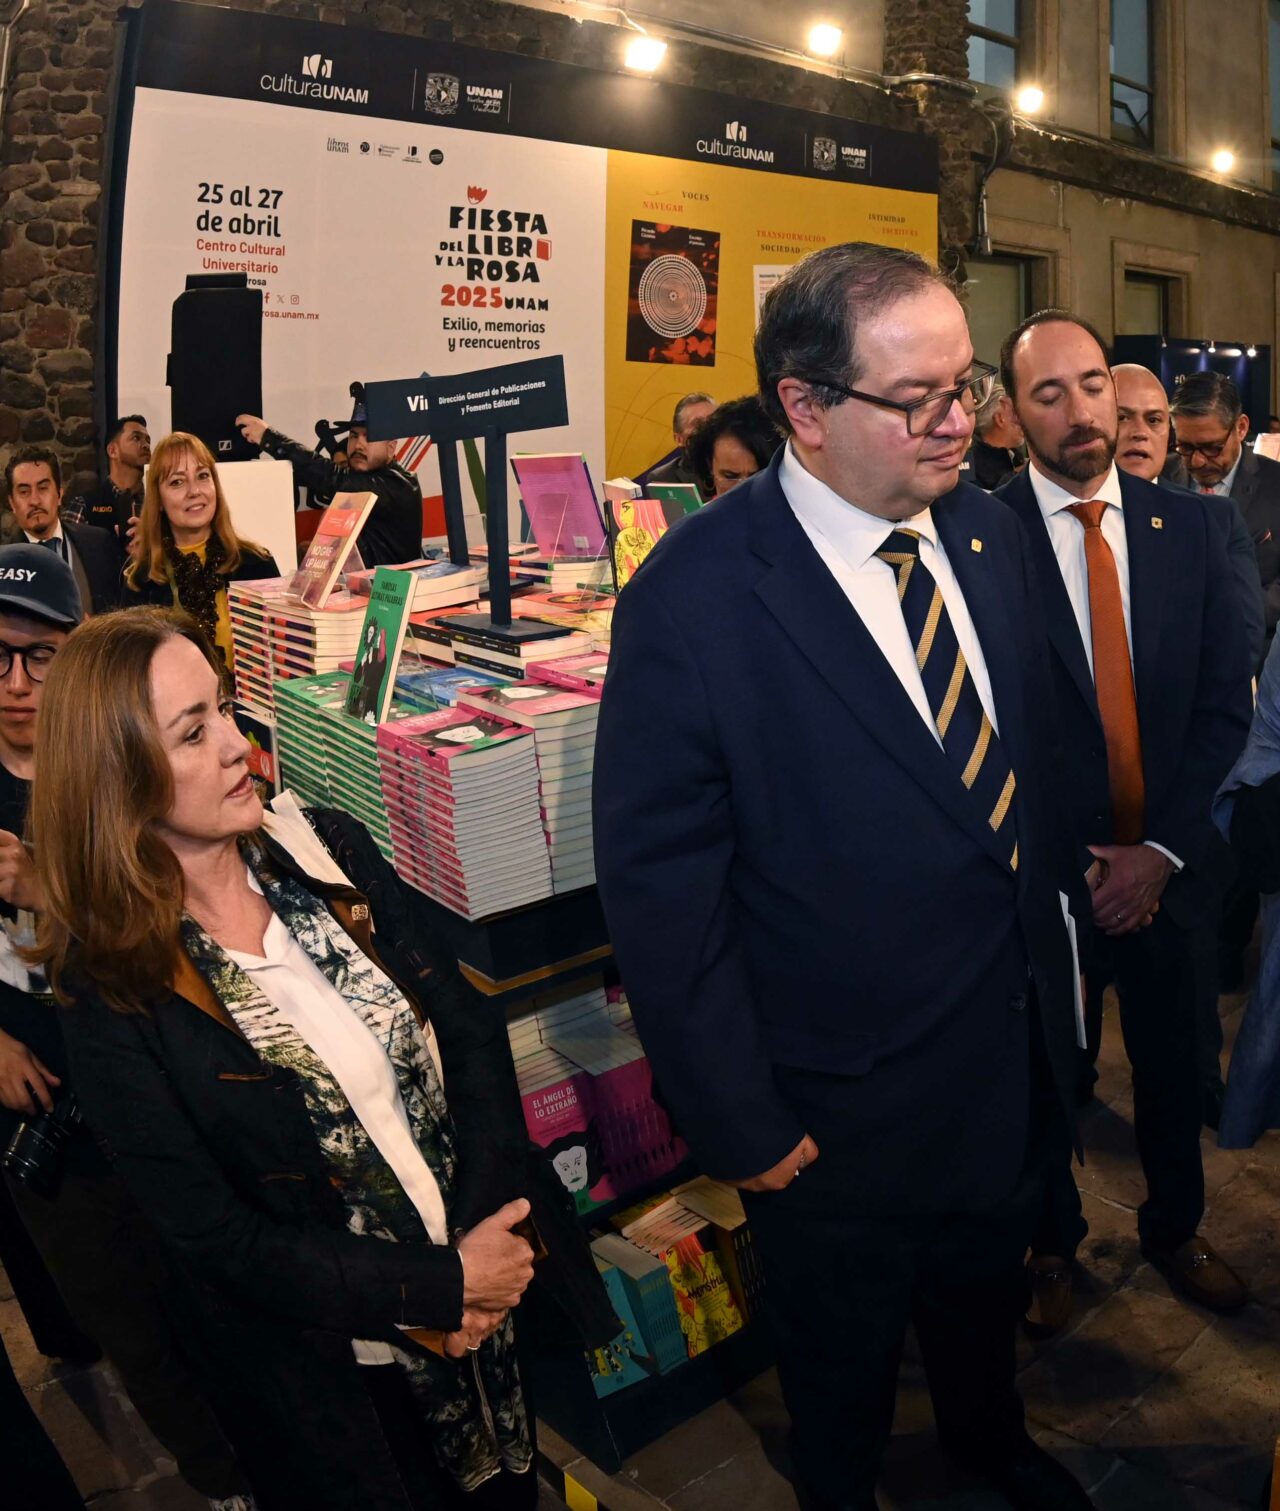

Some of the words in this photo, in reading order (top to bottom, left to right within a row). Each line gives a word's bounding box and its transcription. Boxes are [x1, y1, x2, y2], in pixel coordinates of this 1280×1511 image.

[260, 73, 369, 104] culturaUNAM
[466, 85, 503, 99] UNAM
[696, 138, 774, 163] culturaUNAM
[841, 146, 867, 158] UNAM
[197, 182, 224, 204] 25
[230, 185, 252, 207] al
[257, 188, 284, 209] 27
[682, 191, 710, 201] VOCES
[643, 201, 684, 213] NAVEGAR
[196, 209, 223, 233] de
[228, 213, 281, 238] abril
[449, 206, 548, 234] FIESTA
[868, 213, 906, 224] INTIMIDAD
[756, 230, 827, 243] TRANSFORMACIÓN
[196, 238, 237, 253] Centro
[240, 241, 285, 257] Cultural
[439, 241, 463, 252] DEL
[760, 244, 801, 254] SOCIEDAD
[202, 257, 278, 274] Universitario
[434, 255, 443, 266] Y
[447, 256, 465, 266] LA
[466, 257, 540, 282] ROSA
[440, 284, 503, 308] 2025
[504, 297, 549, 311] UNAM
[443, 316, 481, 333] Exilio,
[485, 320, 545, 334] memorias
[448, 337, 455, 352] y
[459, 336, 540, 350] reencuentros
[438, 393, 465, 405] Dirección
[466, 390, 490, 401] General
[491, 388, 500, 396] de
[500, 379, 546, 395] Publicaciones
[466, 402, 492, 413] Fomento
[493, 397, 520, 409] Editorial
[533, 1099, 541, 1108] EL
[535, 1109, 544, 1119] LO
[546, 1095, 577, 1115] EXTRAÑO
